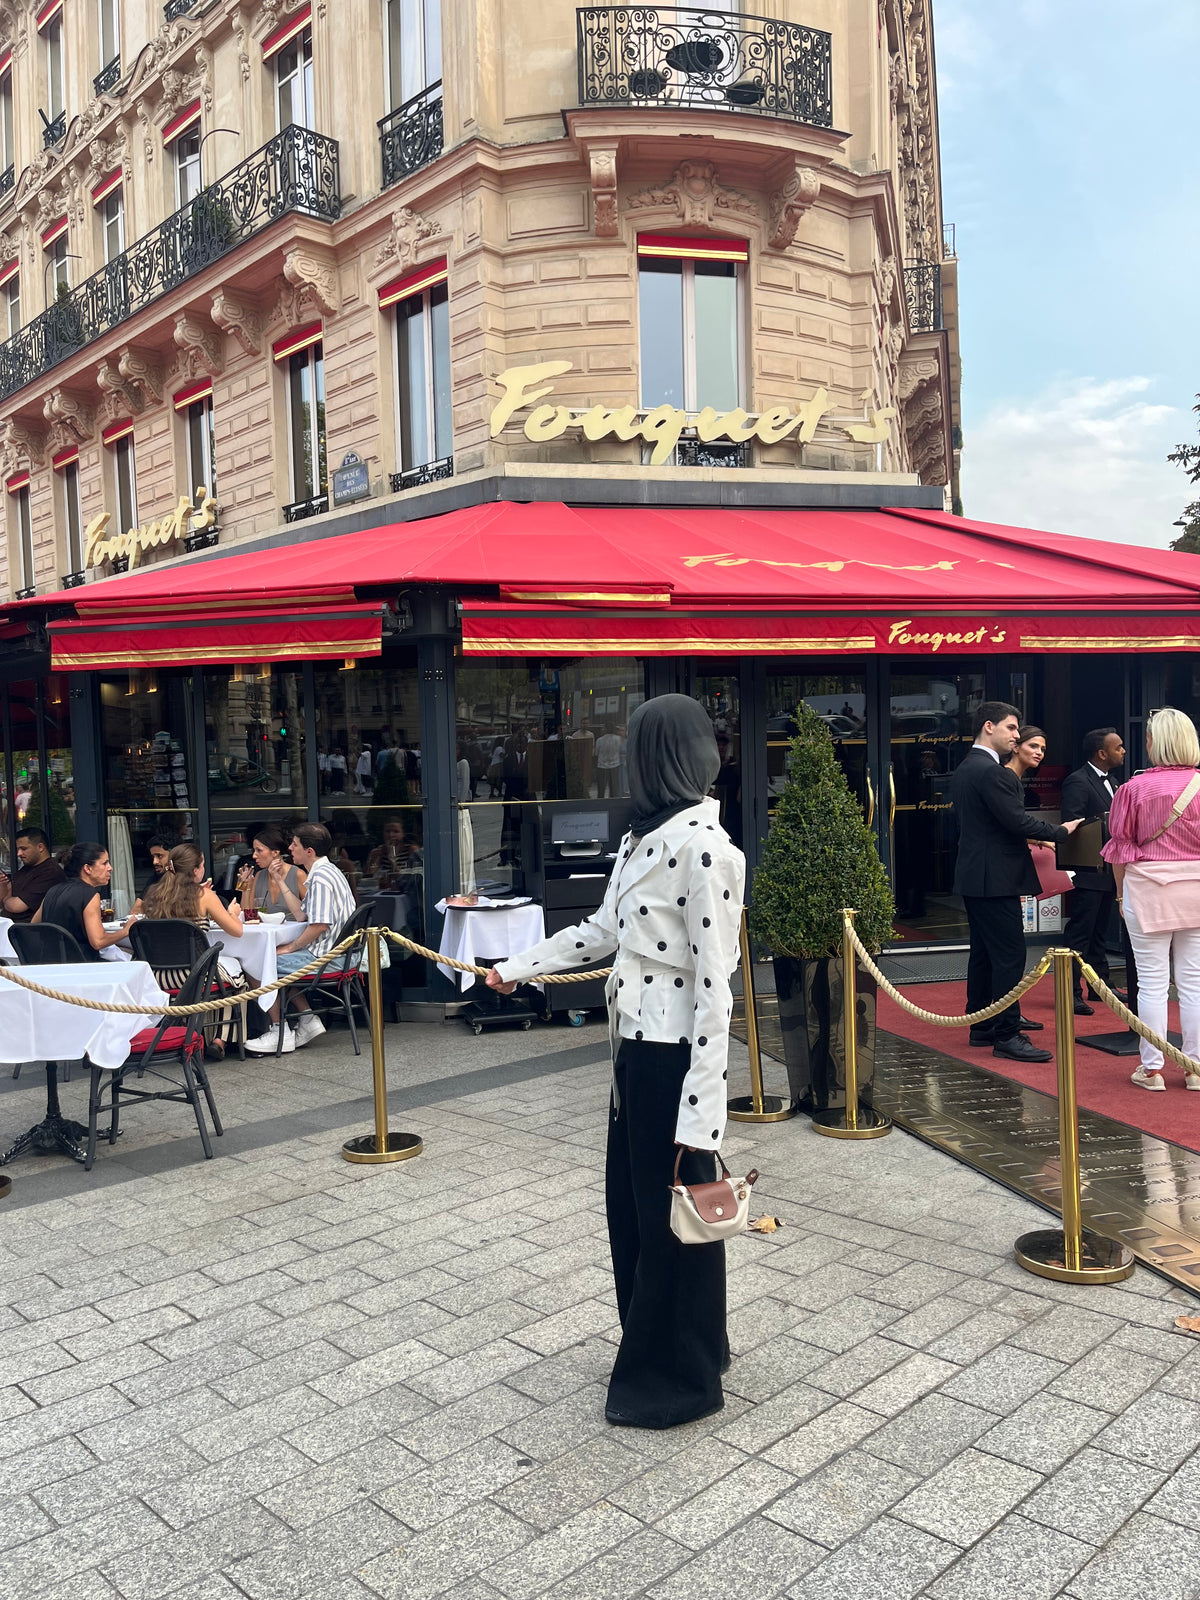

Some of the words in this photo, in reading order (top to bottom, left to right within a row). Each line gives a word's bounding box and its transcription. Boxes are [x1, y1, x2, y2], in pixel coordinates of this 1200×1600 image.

[490, 360, 897, 465] Fouquet's
[85, 486, 217, 571] Fouquet's
[888, 620, 1007, 651] Fouquet's
[918, 800, 954, 811] Fouquet
